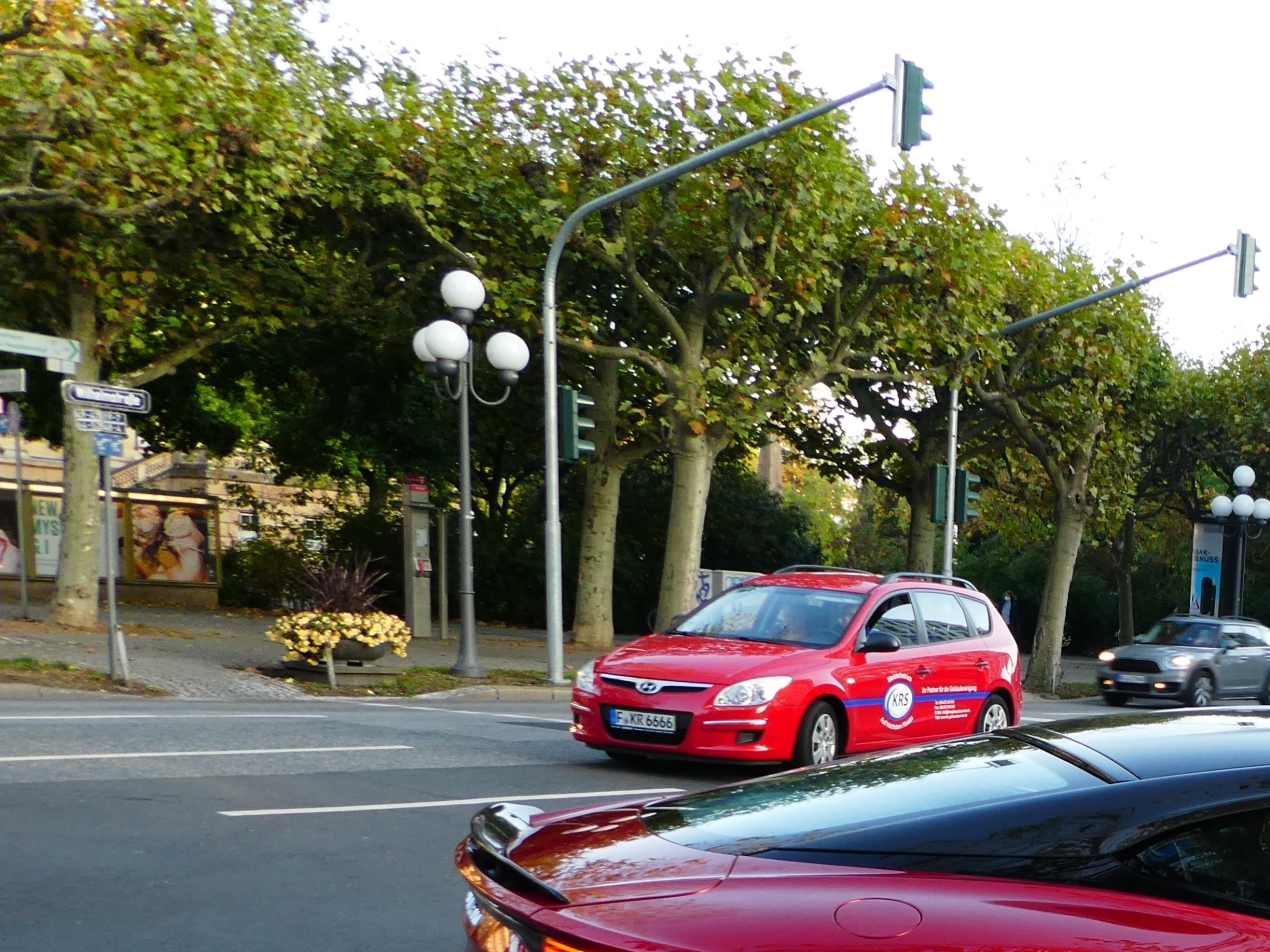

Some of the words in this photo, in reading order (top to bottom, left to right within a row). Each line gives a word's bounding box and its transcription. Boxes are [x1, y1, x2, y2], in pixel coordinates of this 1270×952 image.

[892, 693, 909, 707] KRS
[617, 712, 623, 723] F
[630, 713, 645, 726] KR
[646, 715, 673, 729] 6666
